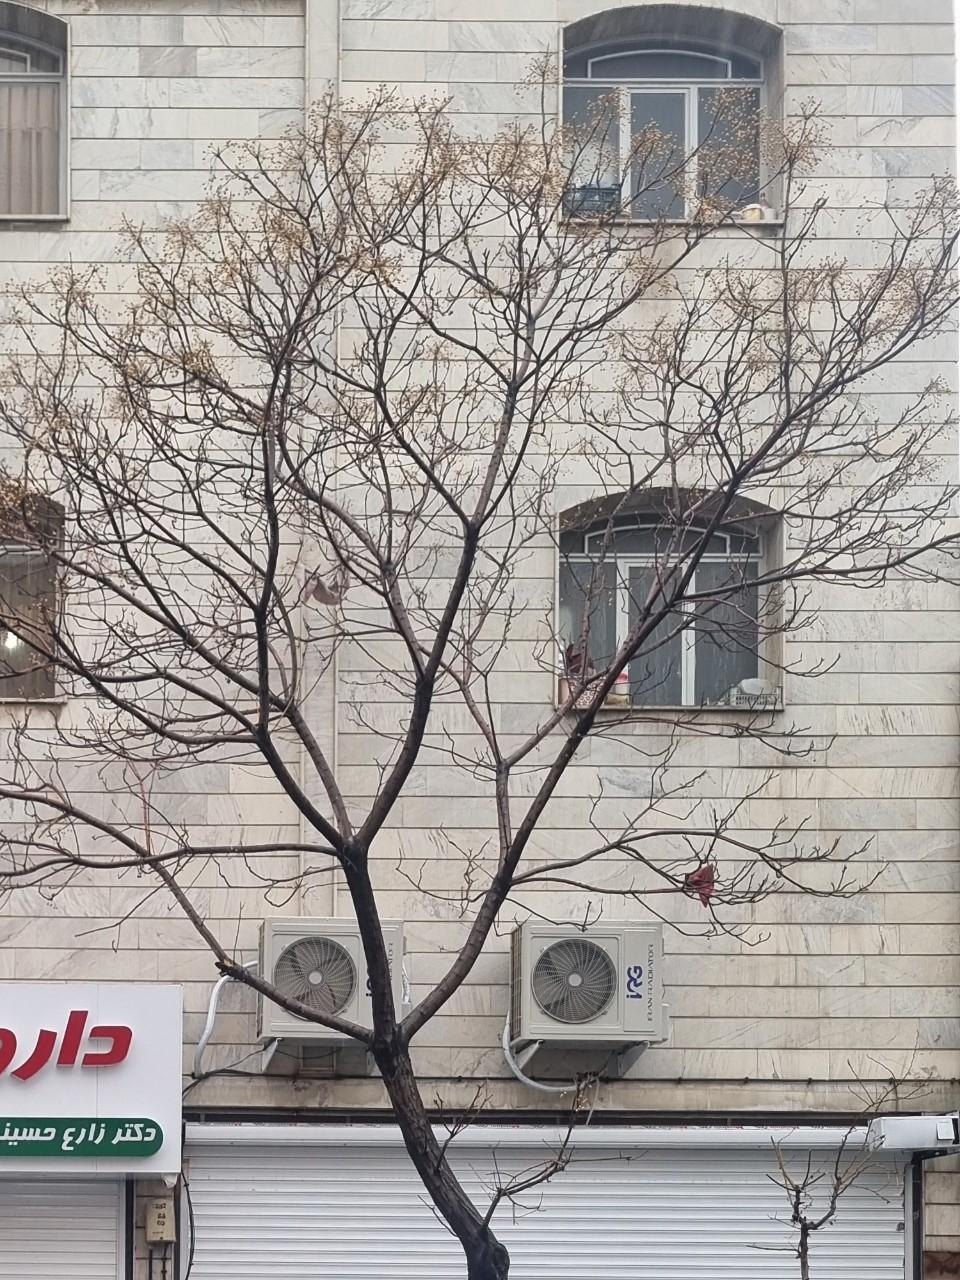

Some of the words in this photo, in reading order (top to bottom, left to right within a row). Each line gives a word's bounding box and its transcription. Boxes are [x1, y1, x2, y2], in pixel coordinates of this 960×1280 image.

[646, 943, 654, 996] RADIATOR
[61, 1123, 106, 1151] زارع
[111, 1123, 157, 1145] دکتر
